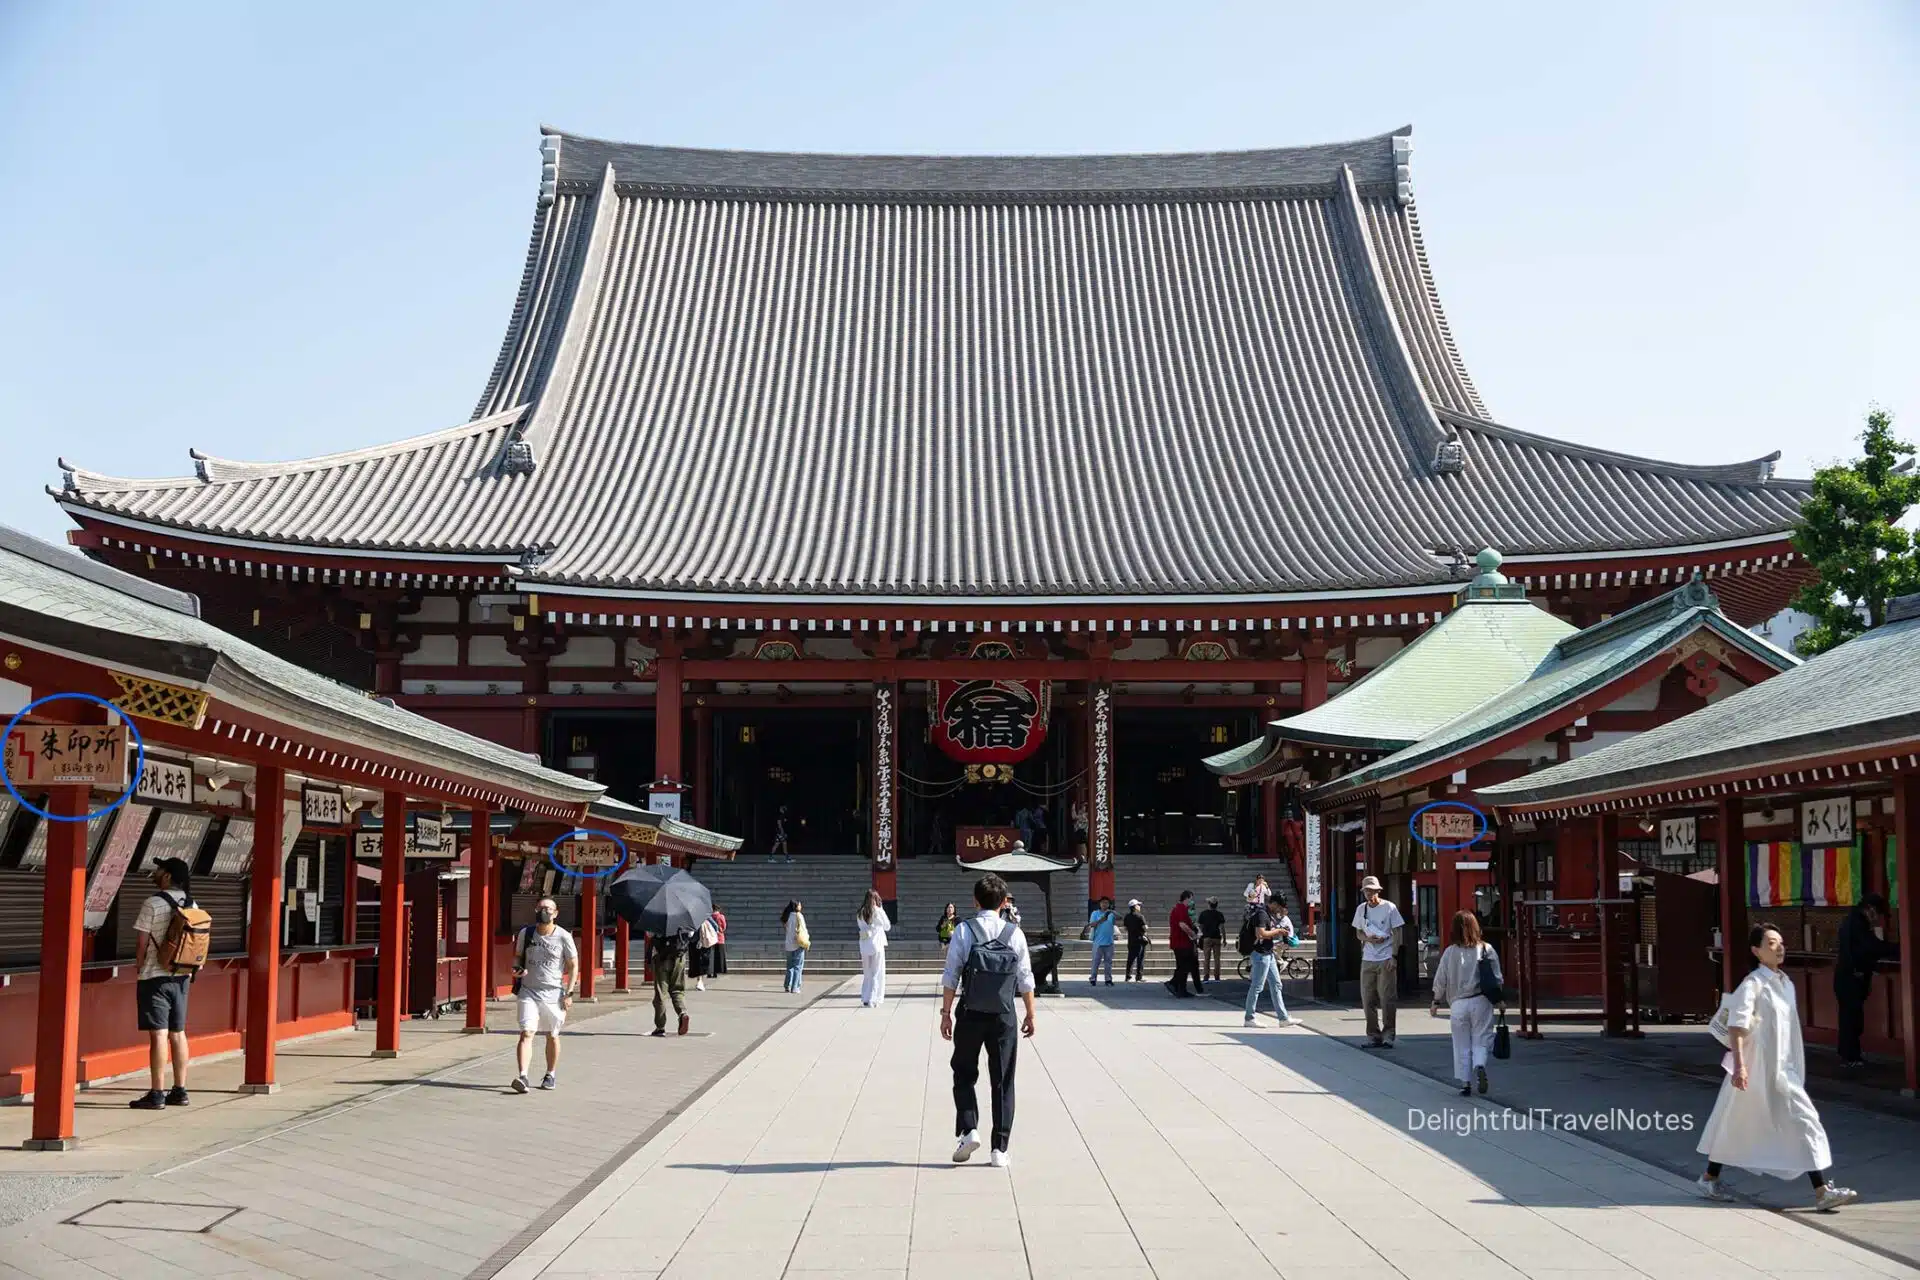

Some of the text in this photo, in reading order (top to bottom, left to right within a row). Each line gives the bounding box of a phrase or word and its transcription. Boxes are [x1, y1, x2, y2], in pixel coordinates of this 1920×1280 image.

[41, 728, 120, 761] 朱印所
[139, 765, 187, 800] お札お守
[305, 793, 338, 820] お札お守
[1807, 804, 1848, 836] みくじ
[1439, 814, 1472, 829] 朱印所
[1665, 822, 1695, 849] みくじ
[576, 843, 612, 857] 朱印所
